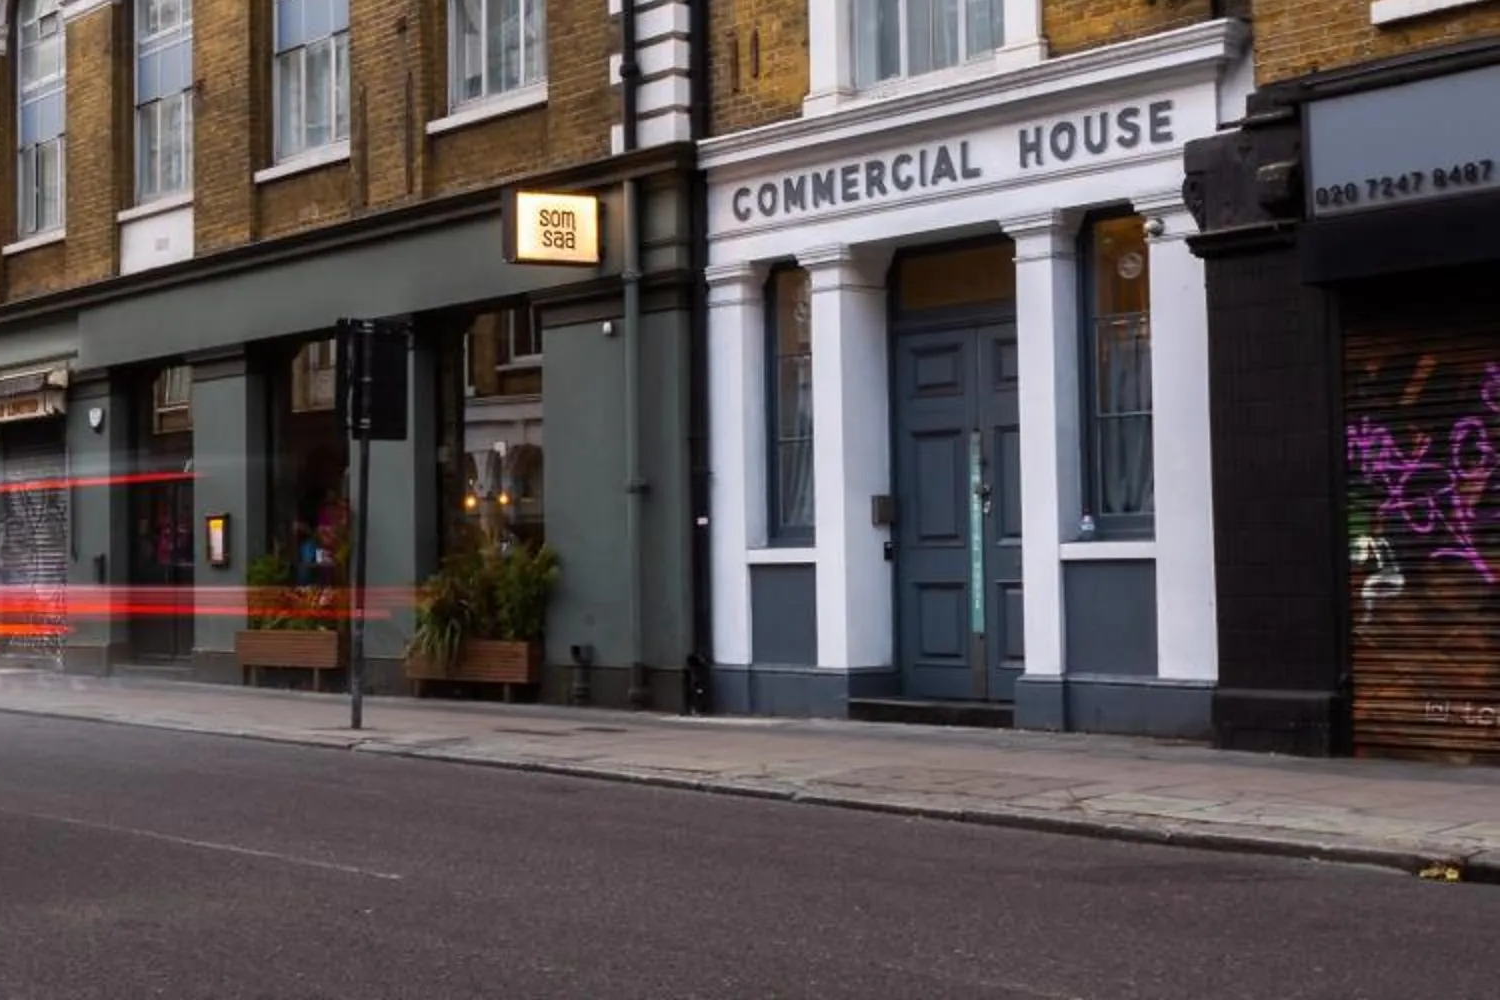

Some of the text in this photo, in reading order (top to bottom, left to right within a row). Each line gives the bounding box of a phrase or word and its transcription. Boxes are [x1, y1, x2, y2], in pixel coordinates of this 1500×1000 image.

[732, 100, 1175, 222] COMMERCIAL HOUSE
[1315, 182, 1358, 206] 020
[1365, 170, 1424, 199] 7247
[539, 209, 576, 231] som
[542, 230, 576, 249] saa
